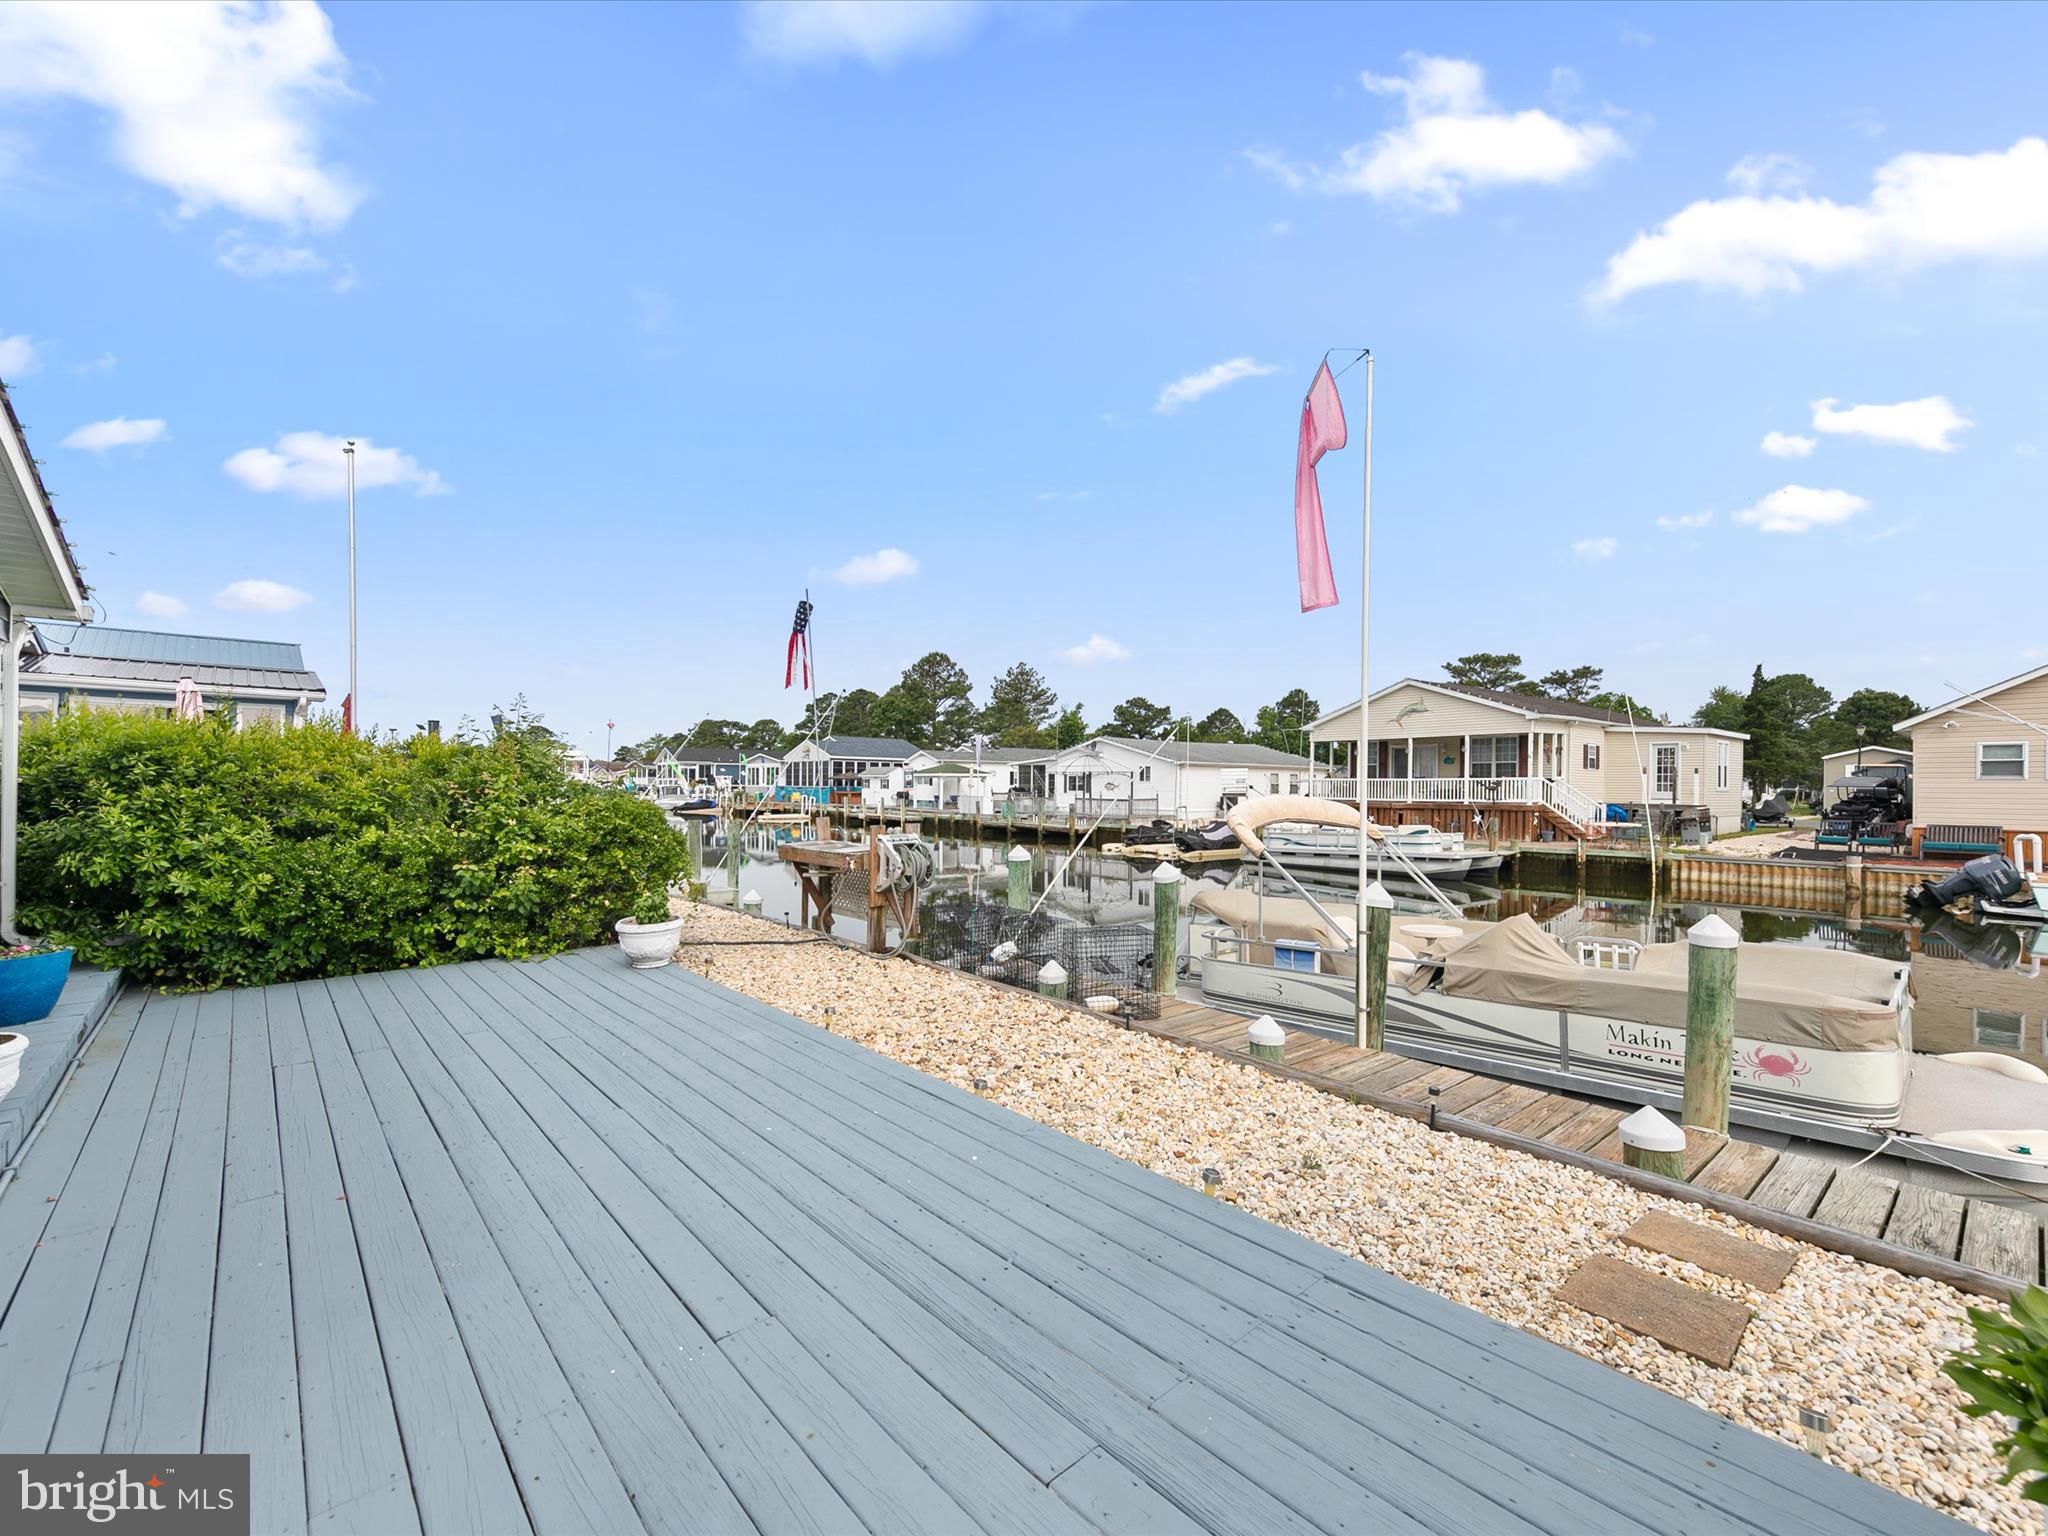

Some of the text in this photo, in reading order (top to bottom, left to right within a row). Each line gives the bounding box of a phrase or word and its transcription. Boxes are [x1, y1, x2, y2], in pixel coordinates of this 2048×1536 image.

[1606, 1024, 1672, 1051] Makin
[1608, 1048, 1654, 1062] LONG
[1660, 1057, 1682, 1067] NE
